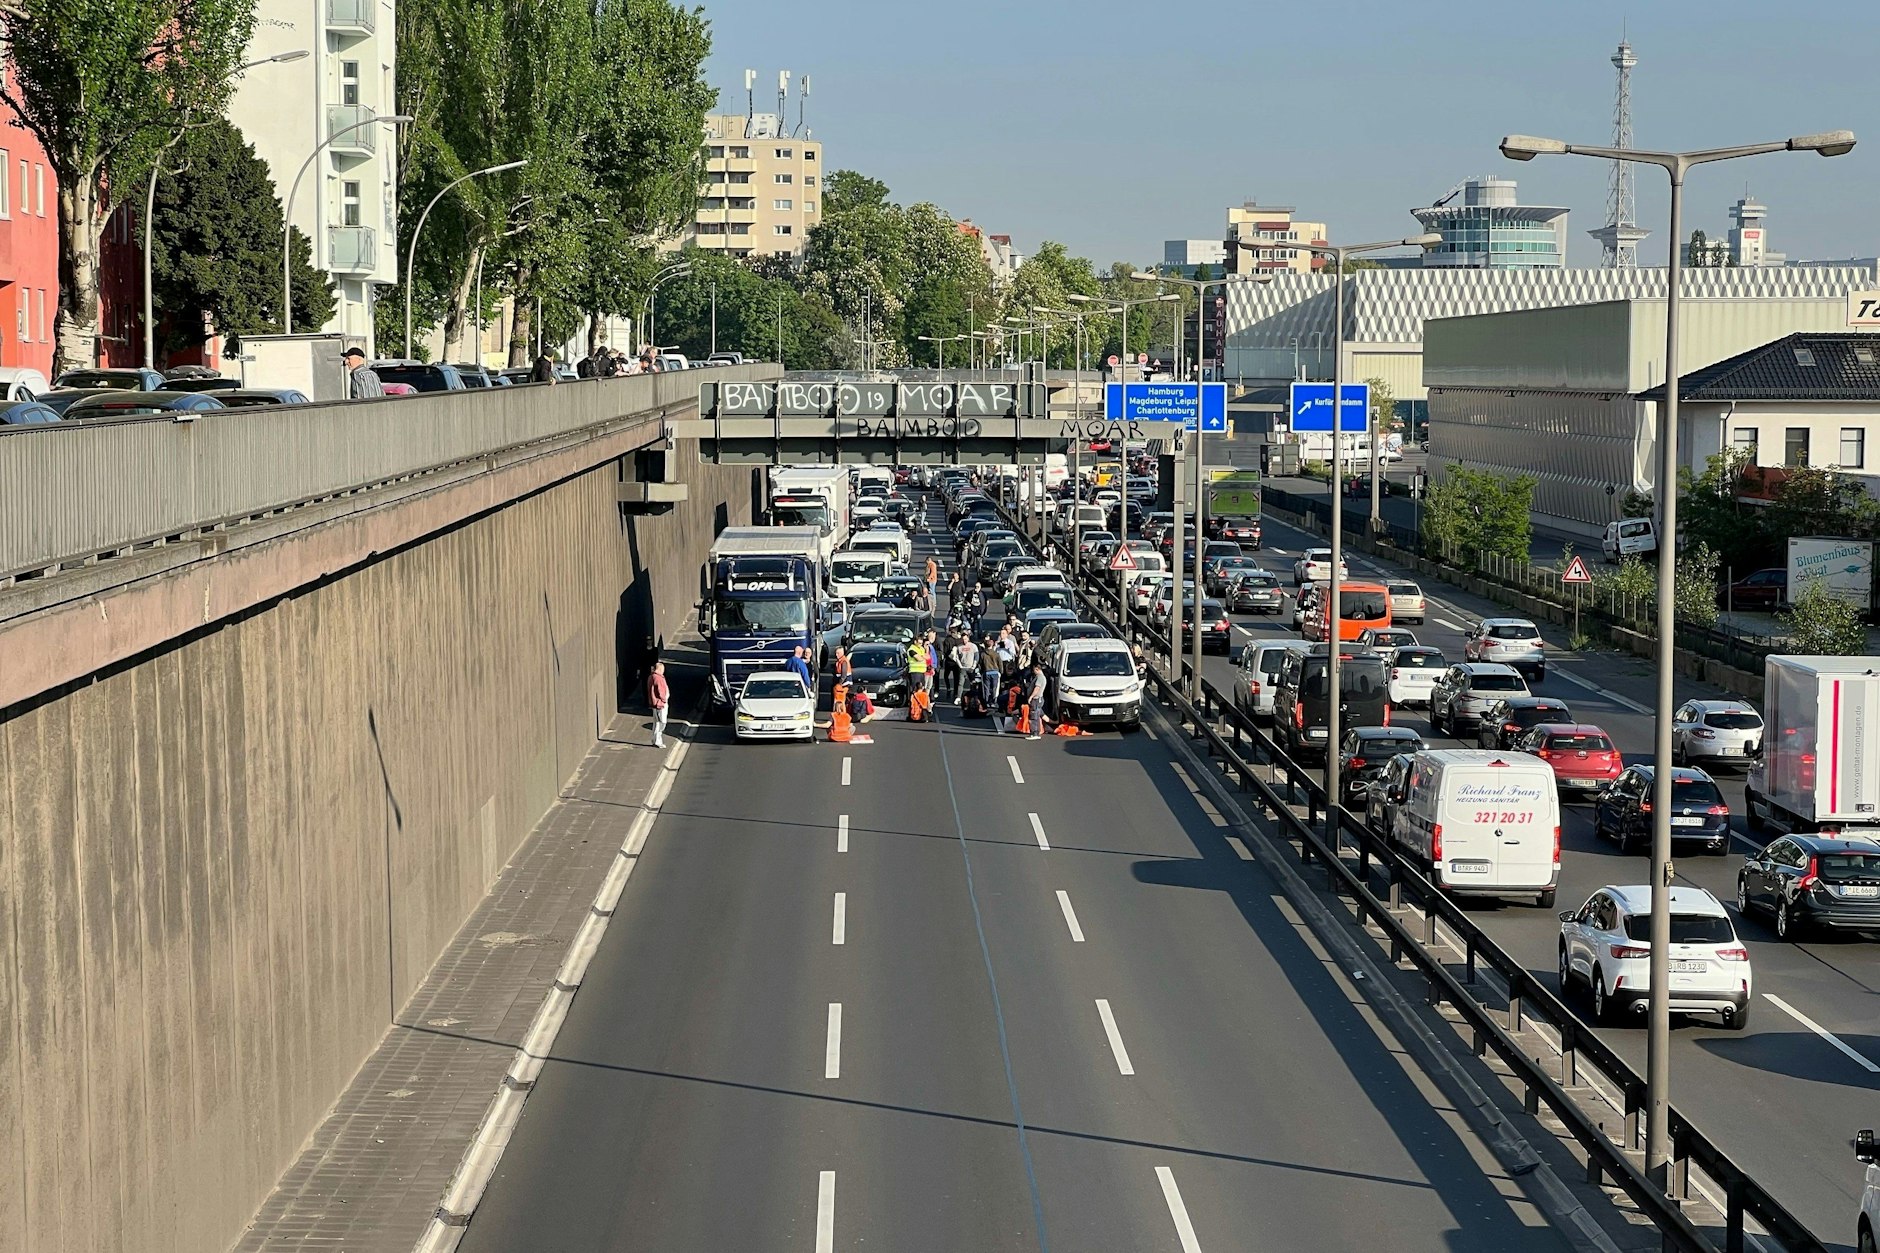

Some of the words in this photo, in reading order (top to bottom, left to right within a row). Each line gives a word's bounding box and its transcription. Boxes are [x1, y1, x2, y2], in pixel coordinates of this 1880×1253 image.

[1148, 387, 1184, 397] Hamburg
[725, 384, 860, 414] BAMBOO
[901, 384, 1017, 414] MOAR
[1129, 397, 1173, 406] Magdeburg
[1175, 397, 1198, 406] Leipzi
[1136, 406, 1196, 416] Charlottenburg
[1060, 420, 1144, 440] MOAR
[1795, 546, 1861, 568] Blumenhaus
[748, 581, 774, 591] OPR
[1457, 784, 1507, 797] Richard
[1507, 784, 1542, 801] Franz
[1474, 812, 1497, 823] 321
[1500, 812, 1516, 823] 20
[1518, 812, 1534, 824] 31
